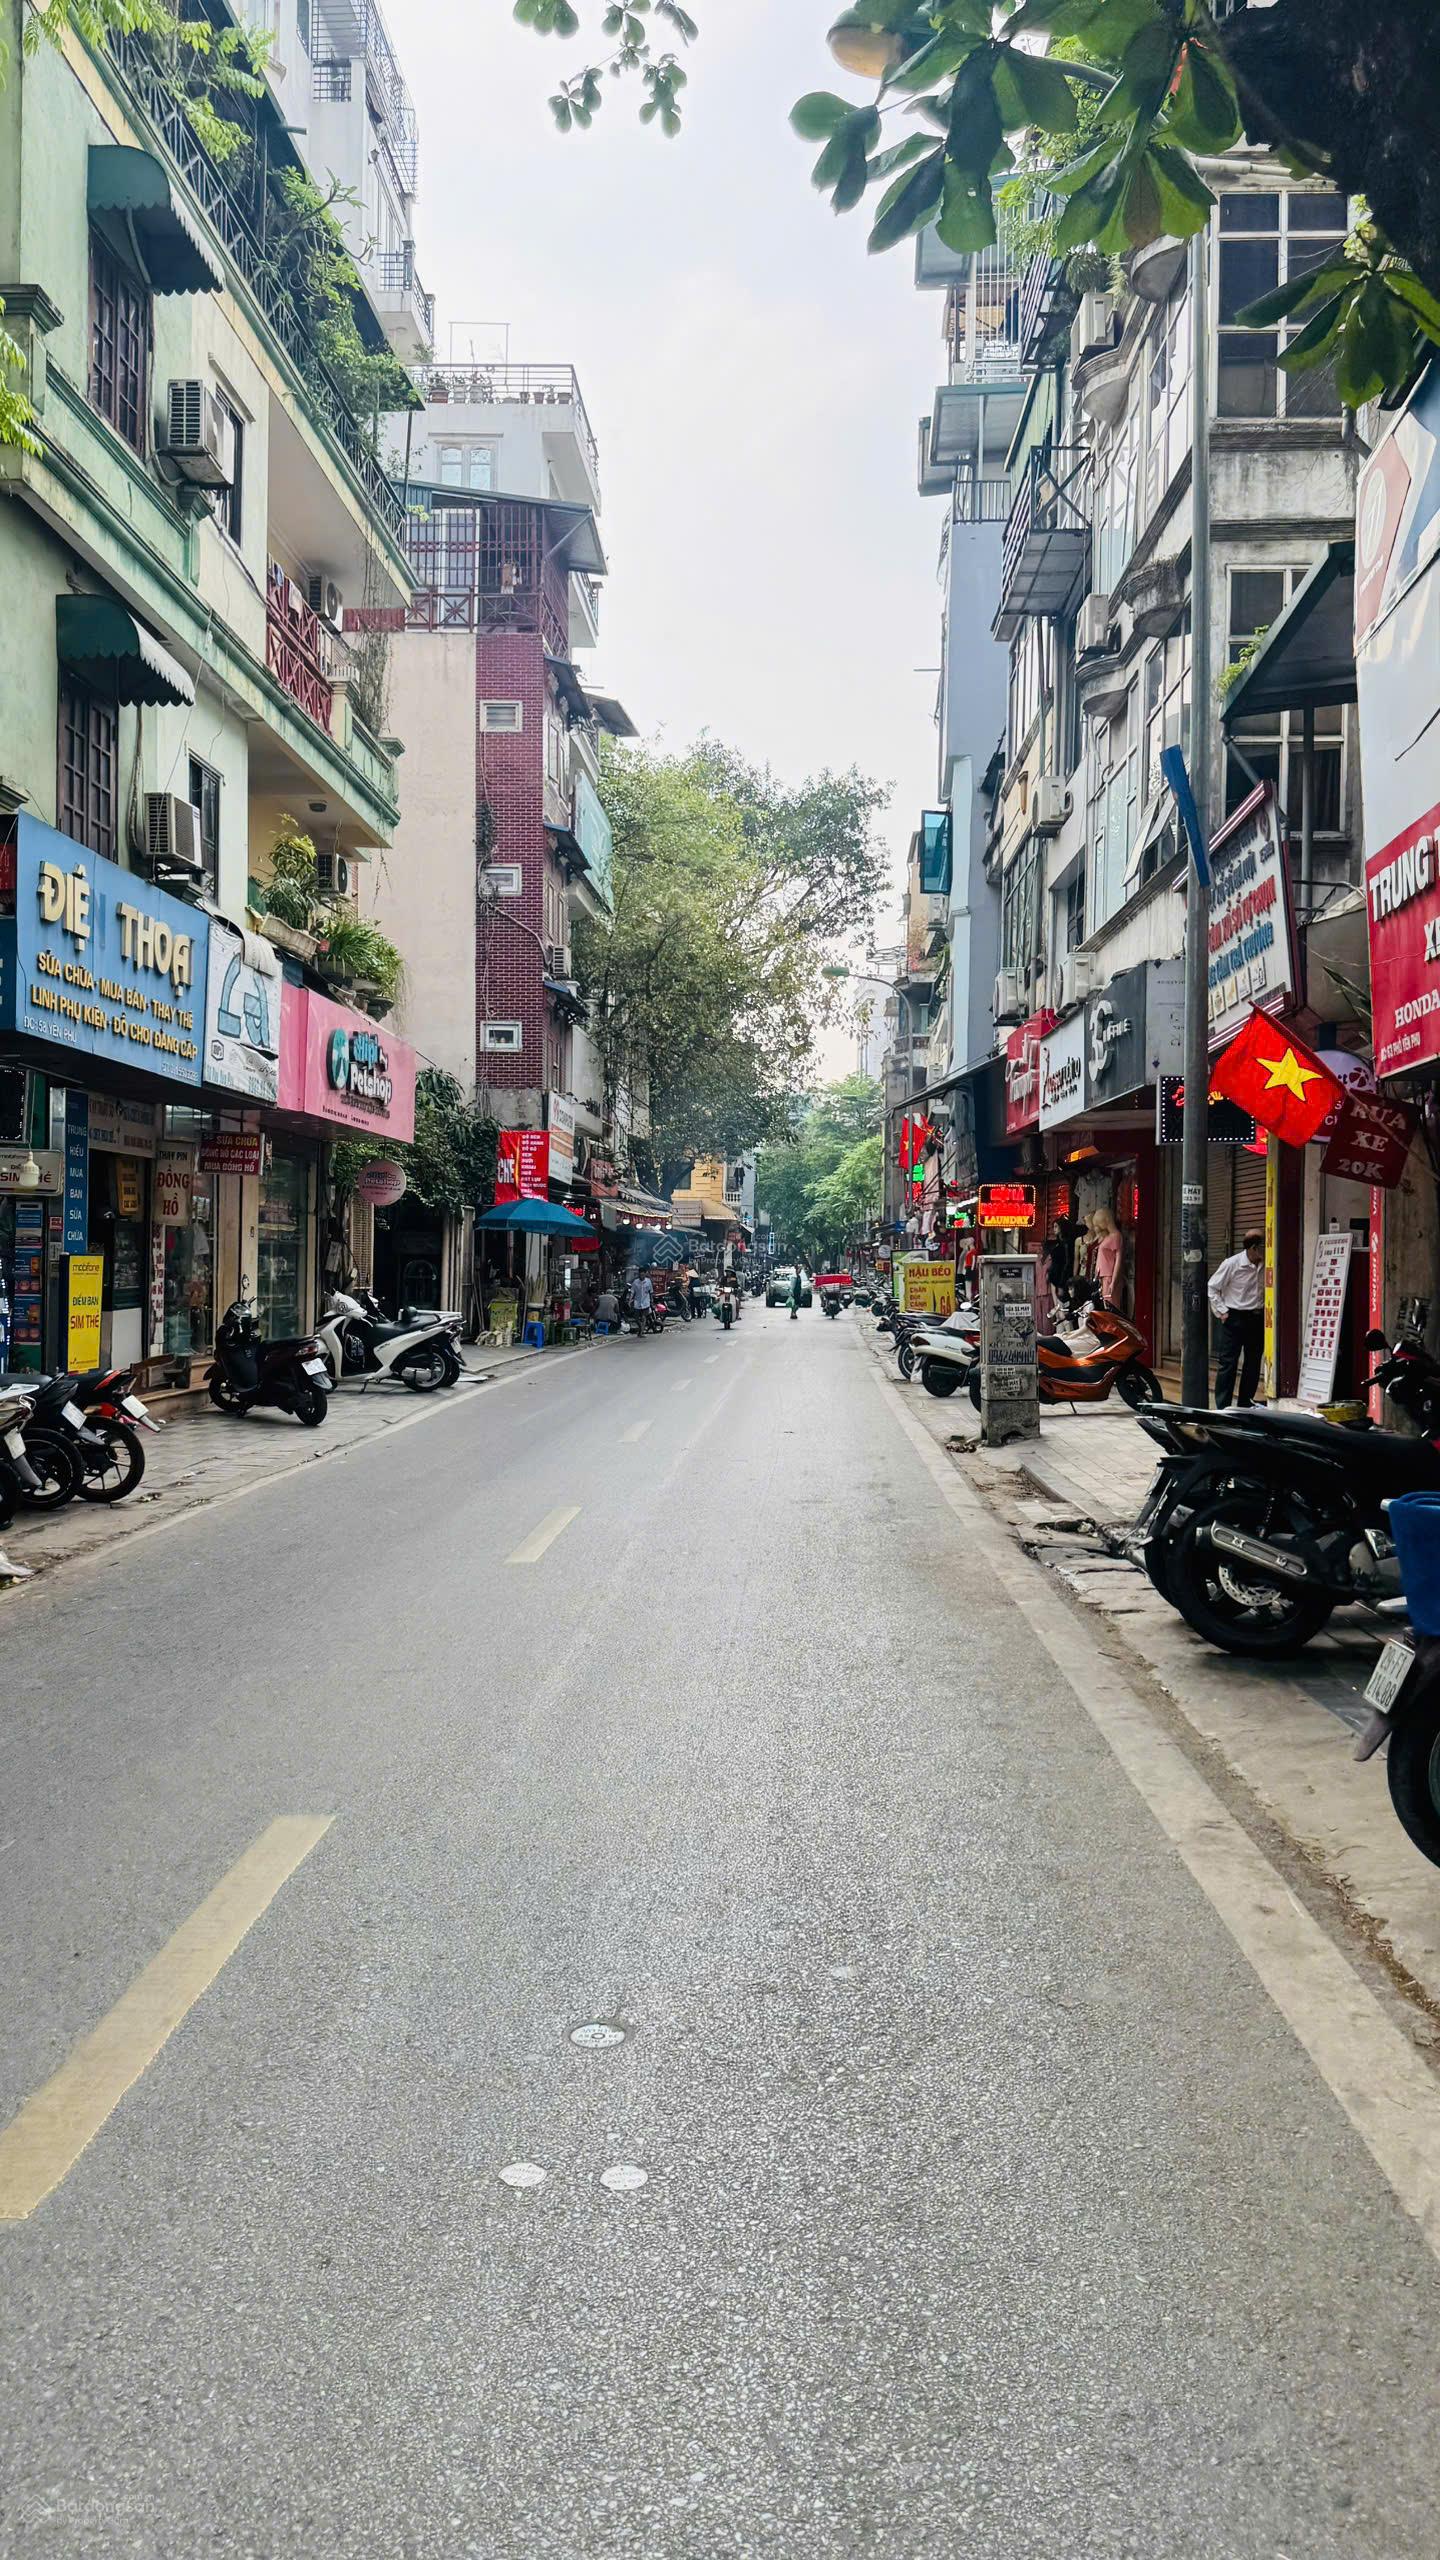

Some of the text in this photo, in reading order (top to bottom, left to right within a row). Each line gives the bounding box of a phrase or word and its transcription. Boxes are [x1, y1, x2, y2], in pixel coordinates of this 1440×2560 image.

[1370, 835, 1433, 922] TRUNG
[31, 984, 58, 1012] LINH
[59, 994, 81, 1025] PHỤ
[100, 978, 123, 1001] MUA
[126, 986, 146, 1013] BÁN
[152, 998, 176, 1024] THAY
[1394, 988, 1440, 1029] HONDA
[350, 1063, 392, 1107] Petshop
[67, 1124, 87, 1137] TRUNG
[1350, 1131, 1389, 1152] XE
[70, 1167, 84, 1179] MUA
[157, 1164, 191, 1189] ĐỒNG
[498, 1154, 515, 1183] CHÈ
[1337, 1159, 1385, 1179] 20K
[162, 1192, 179, 1216] HỒ
[984, 1216, 1030, 1225] LAUNDRY
[72, 1262, 100, 1272] mobifone
[70, 1314, 84, 1330] SIM
